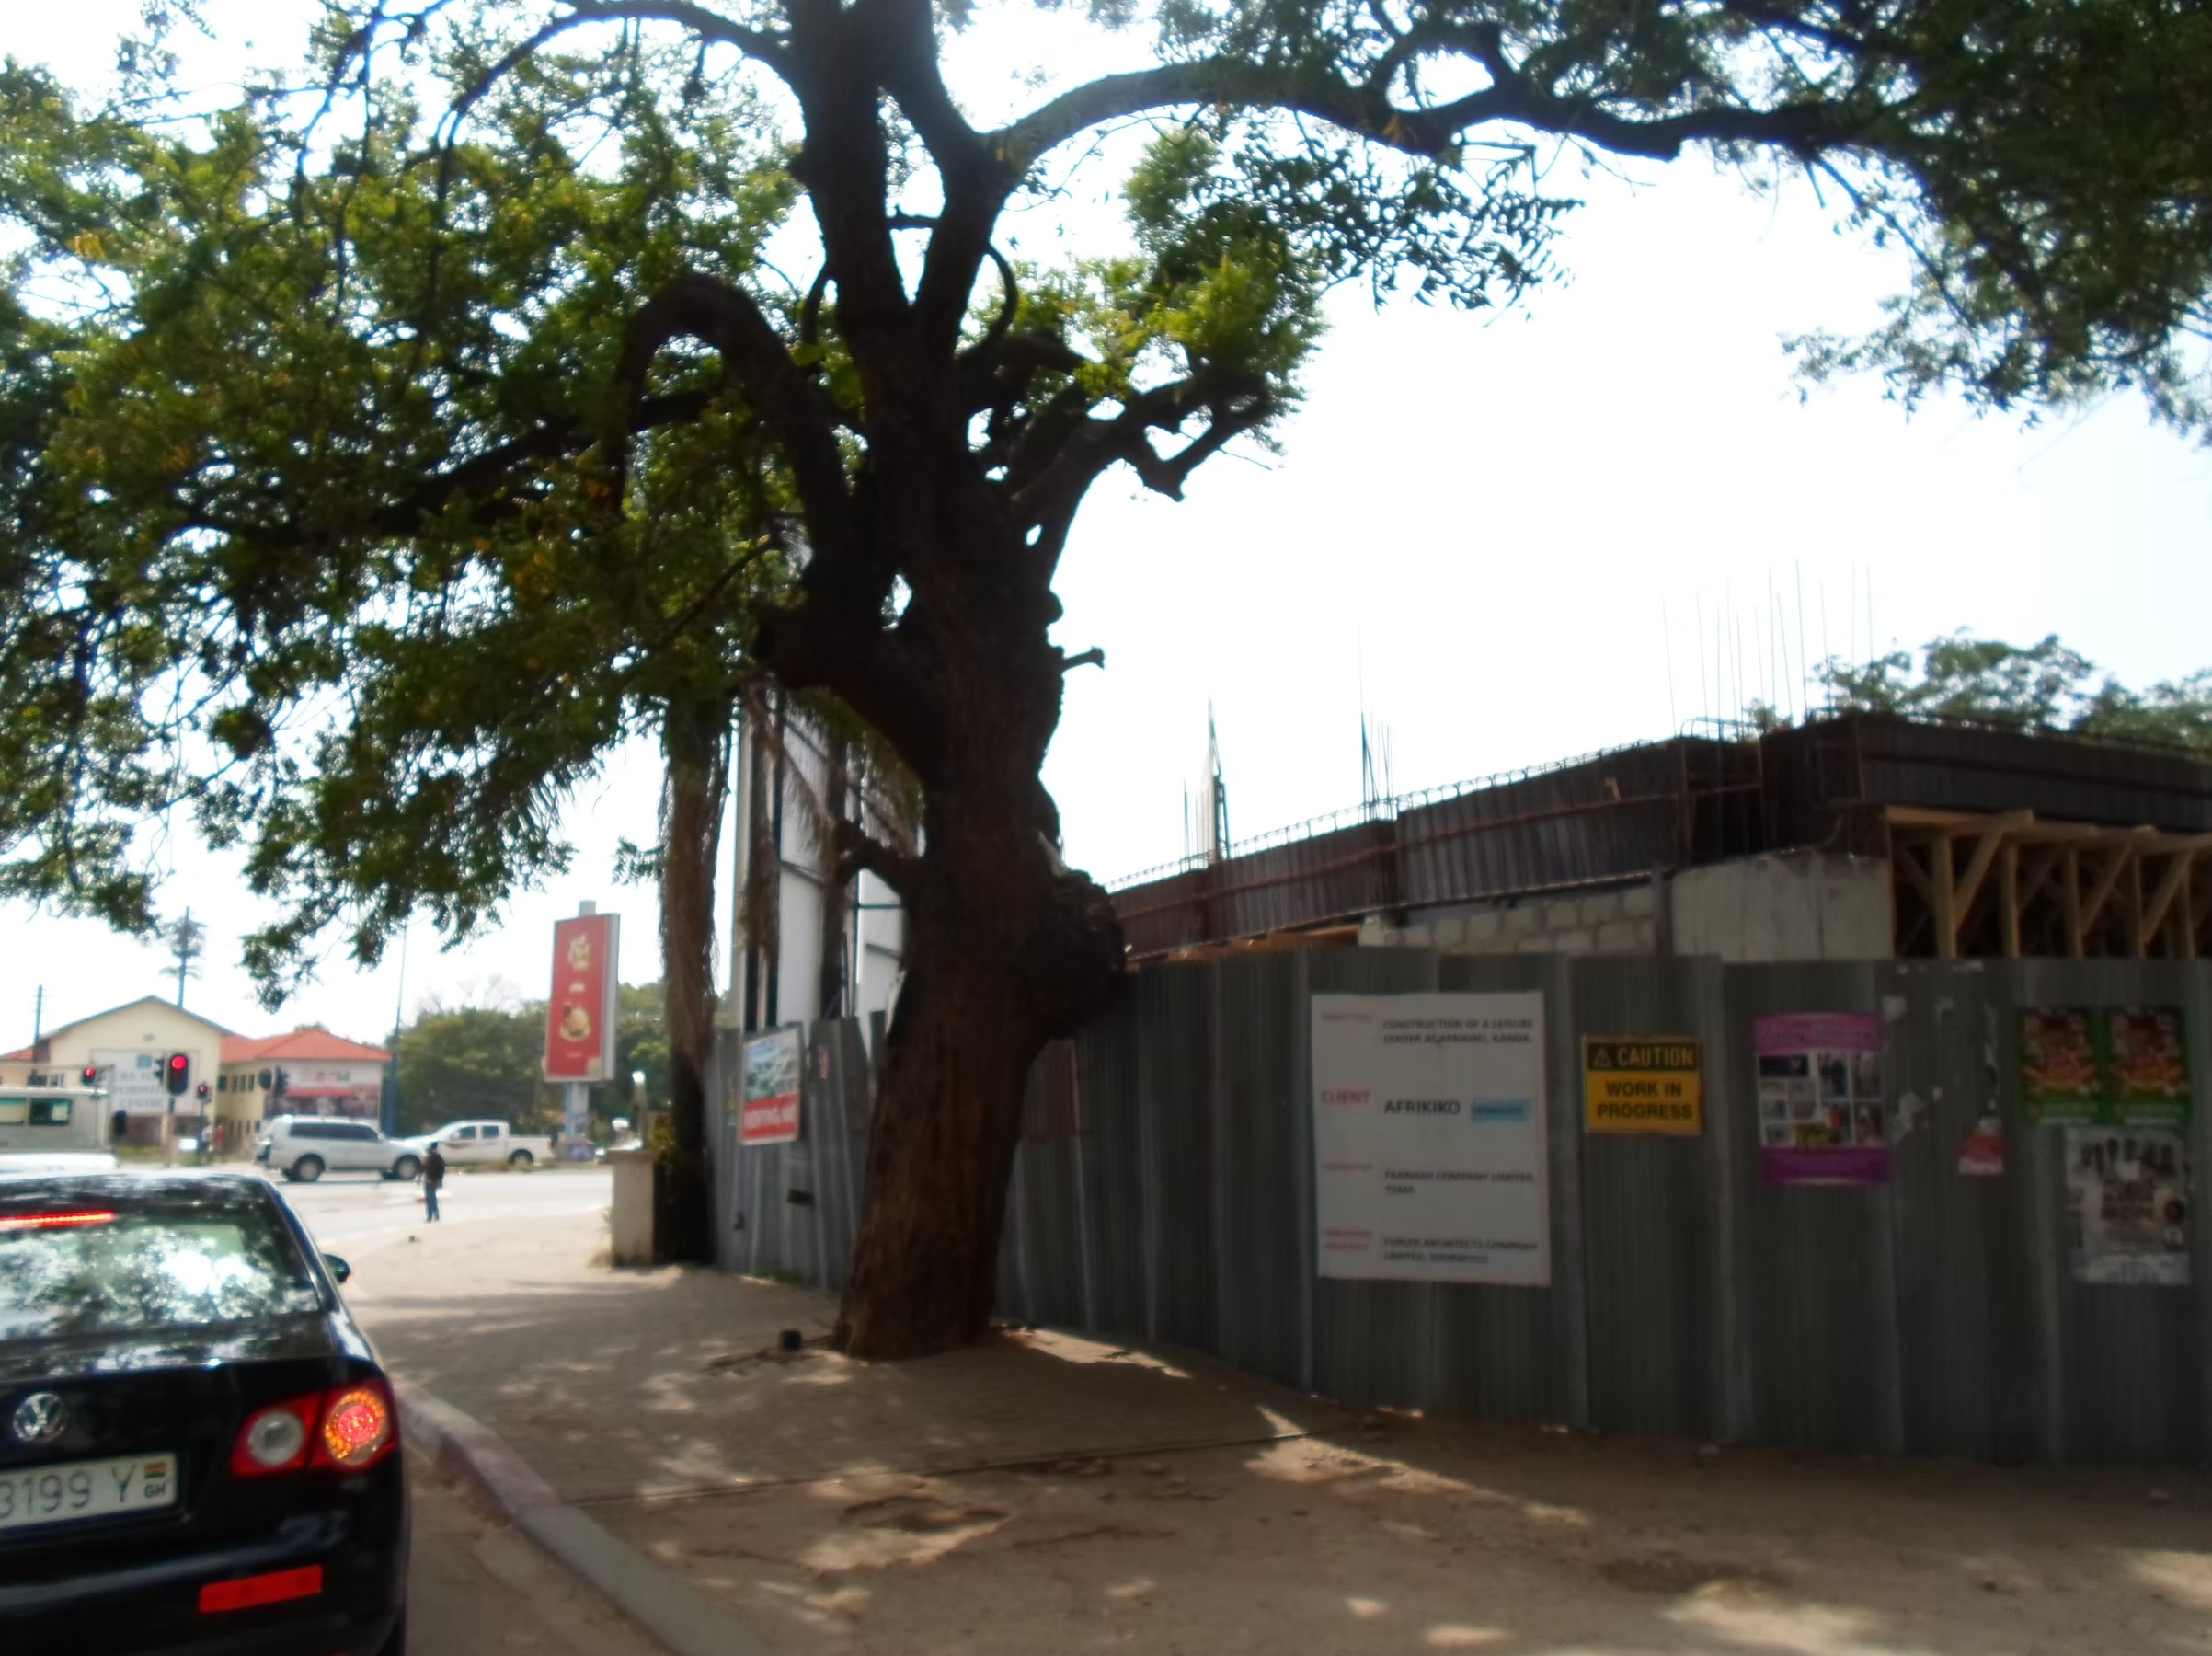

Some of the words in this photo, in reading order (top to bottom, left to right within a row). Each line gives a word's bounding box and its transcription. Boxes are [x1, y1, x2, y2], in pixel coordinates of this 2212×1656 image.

[1618, 1045, 1693, 1068] CAUTION
[1321, 1090, 1370, 1105] CLIENT
[1606, 1081, 1658, 1098] WORK
[1665, 1081, 1682, 1098] IN
[1384, 1099, 1461, 1115] AFRIKIKO
[1598, 1102, 1693, 1120] PROGRESS
[111, 1462, 137, 1503] Y
[144, 1482, 166, 1498] GH
